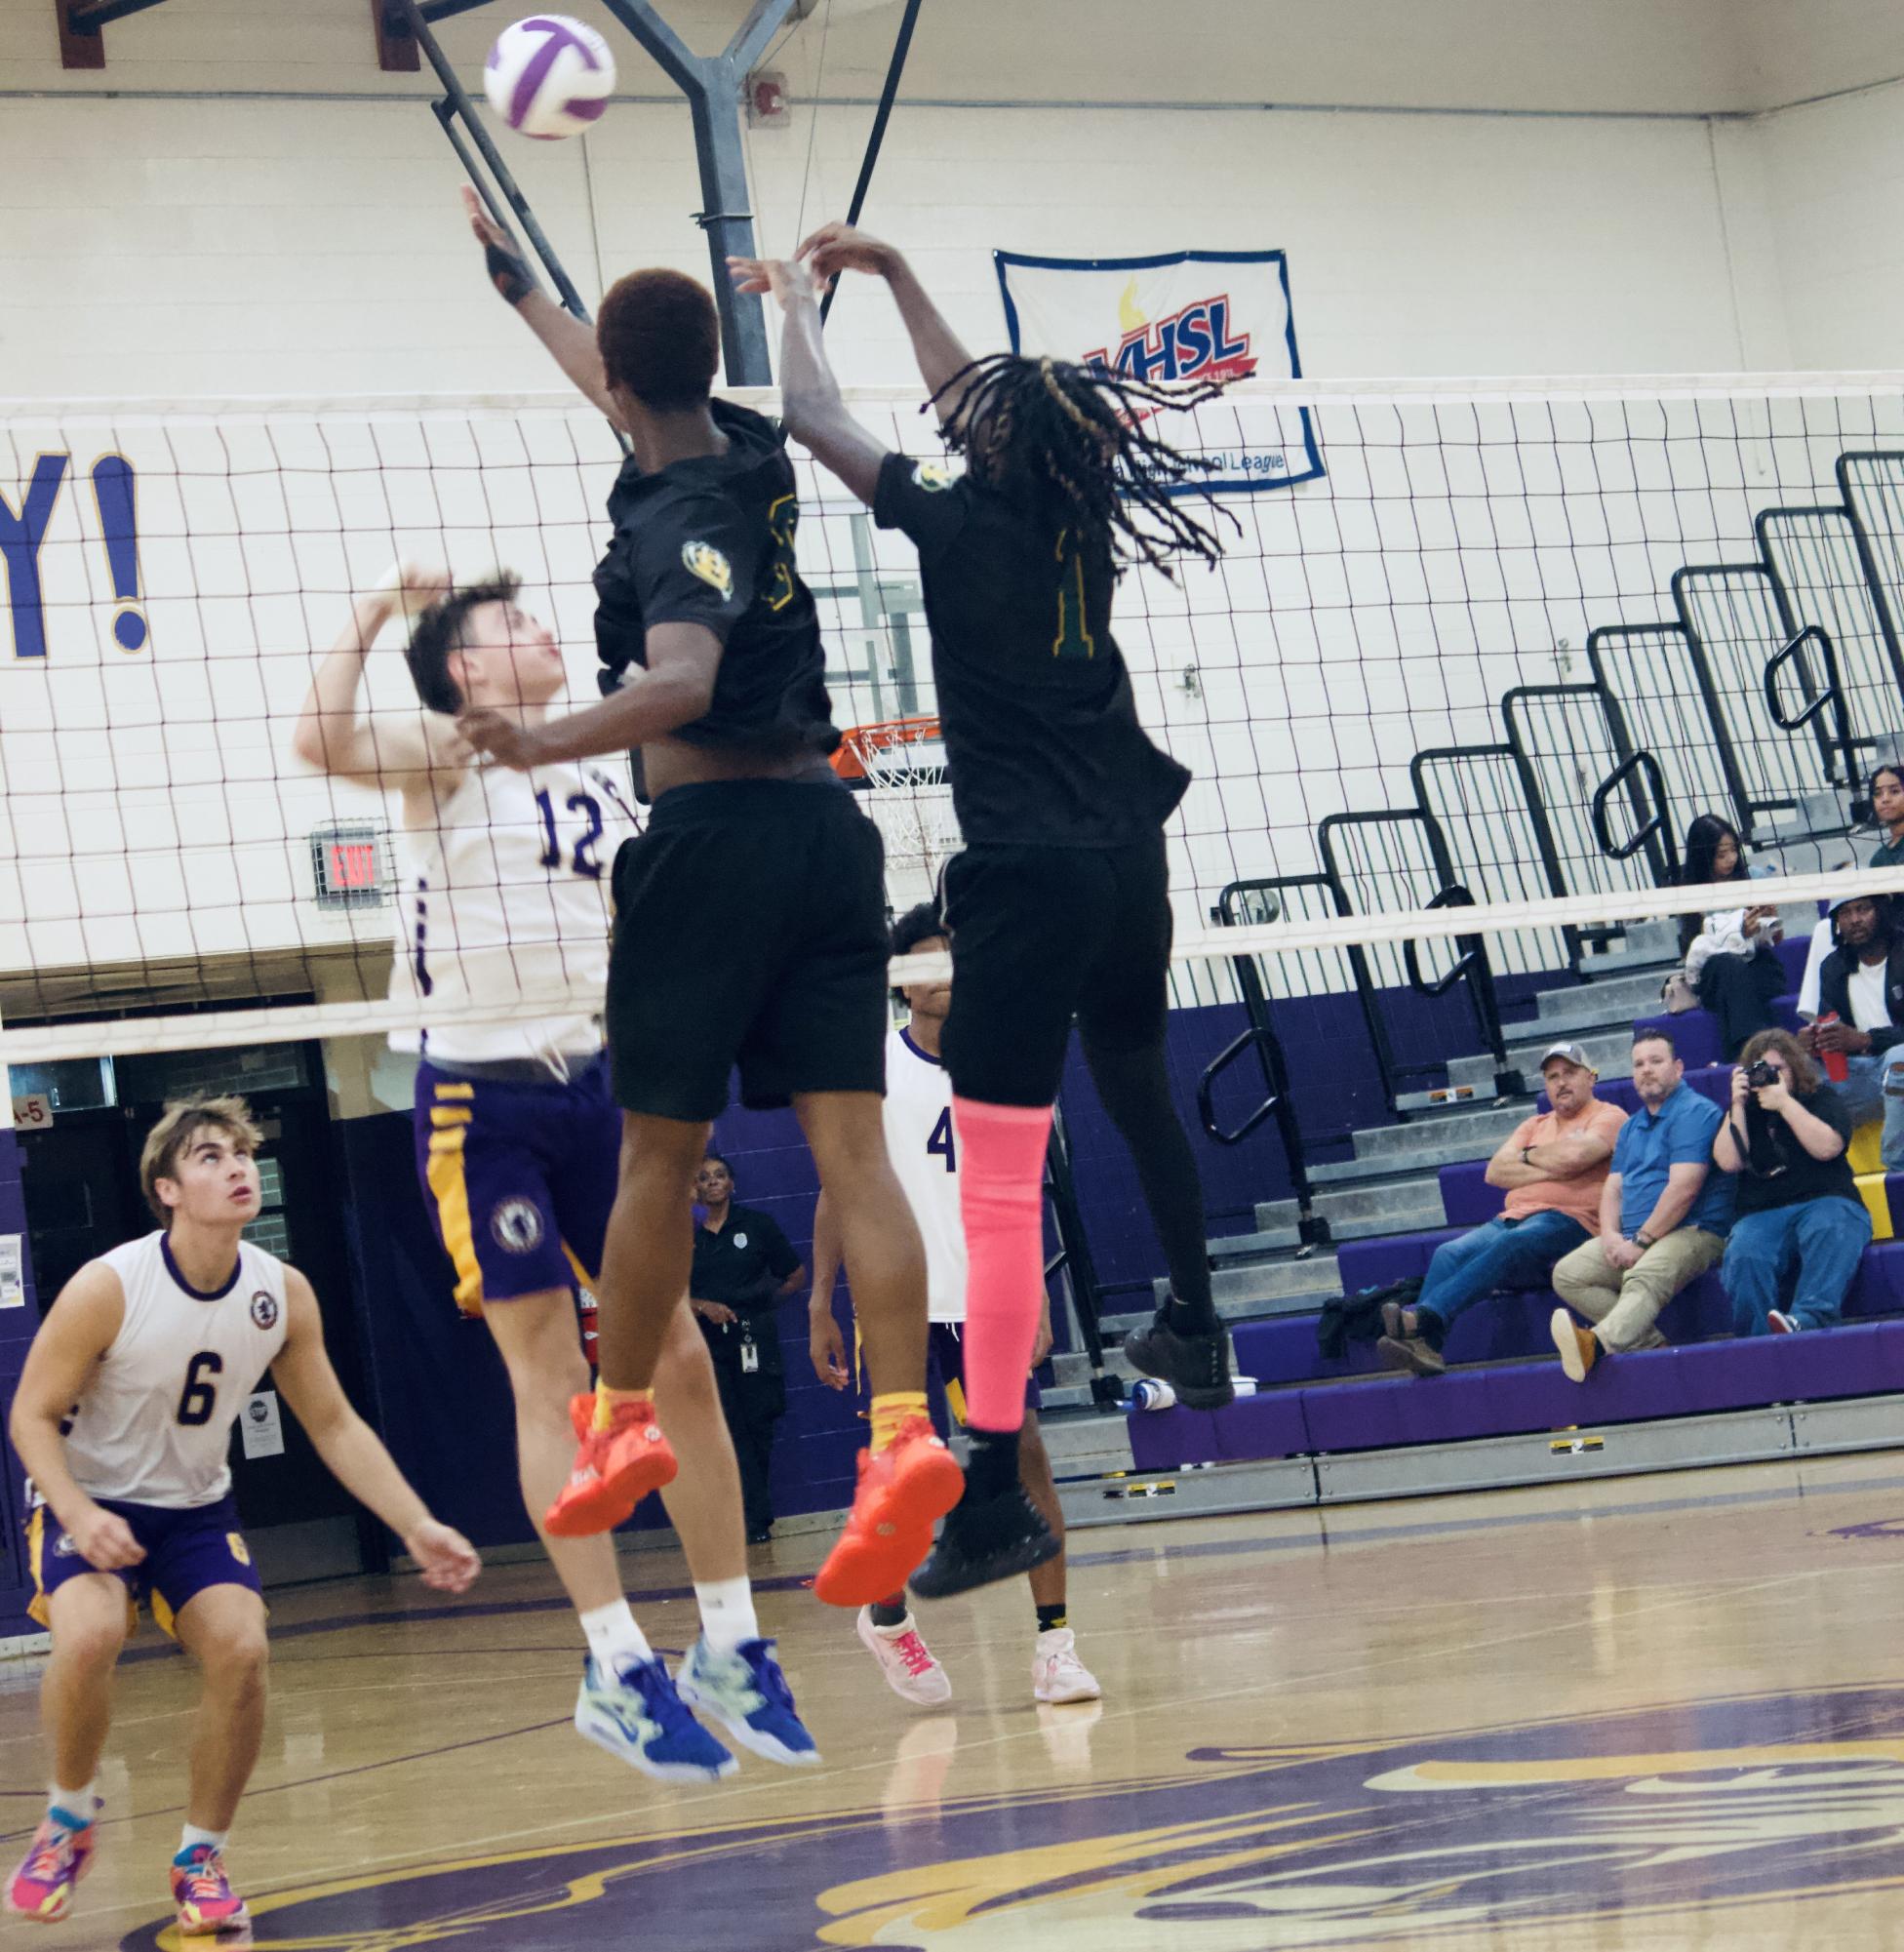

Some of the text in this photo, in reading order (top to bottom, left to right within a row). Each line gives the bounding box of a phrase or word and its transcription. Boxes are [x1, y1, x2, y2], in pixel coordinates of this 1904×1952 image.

[1231, 453, 1286, 473] League
[536, 788, 604, 878] 12
[927, 1105, 956, 1173] 4
[177, 1351, 223, 1426] 6
